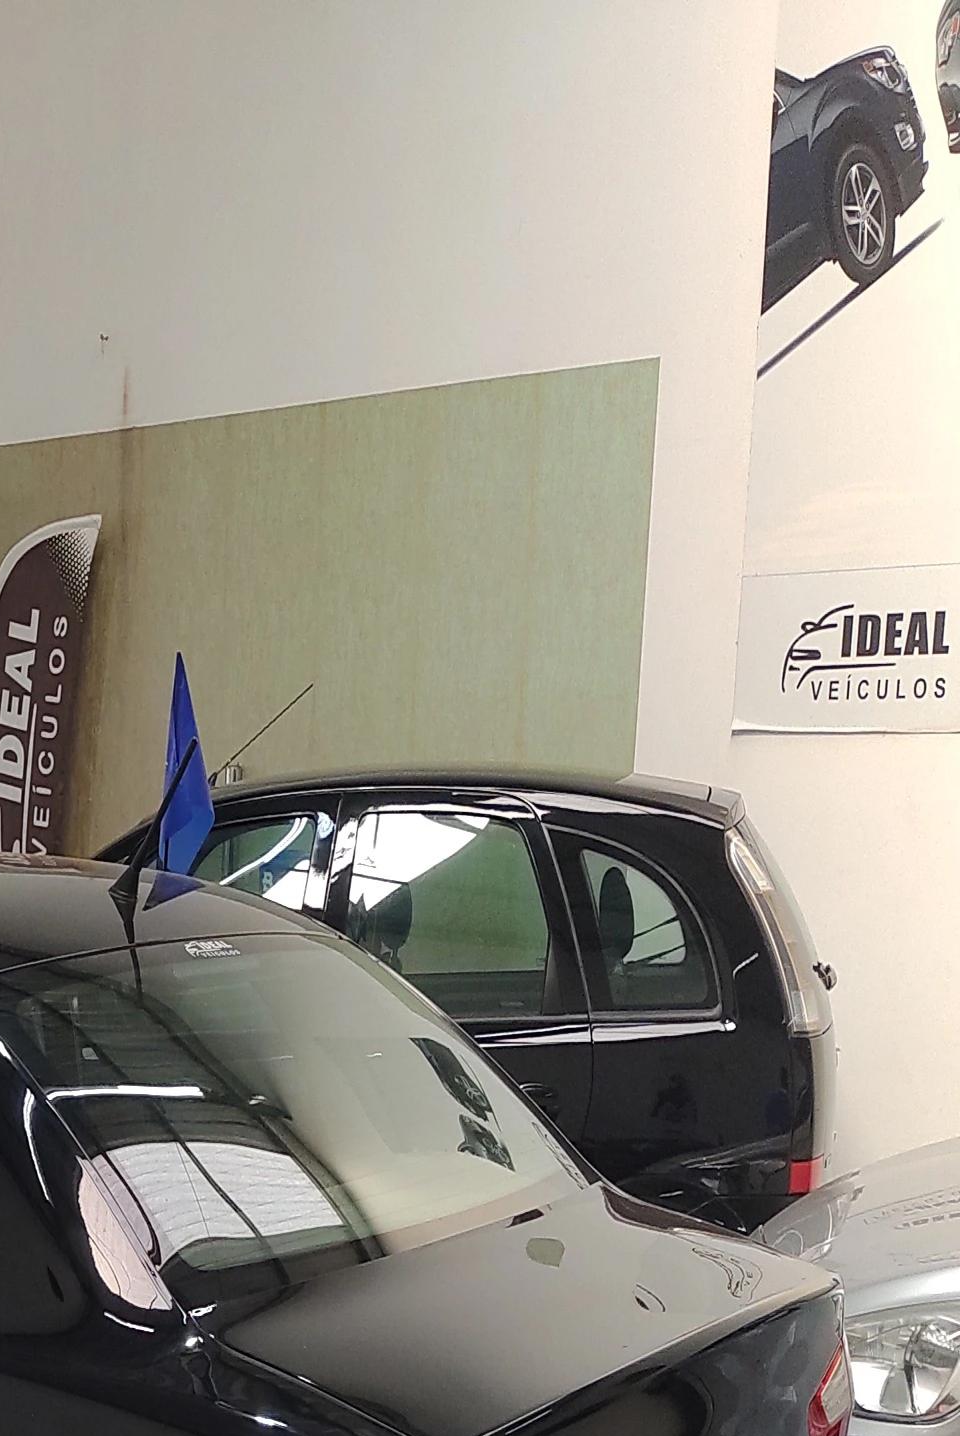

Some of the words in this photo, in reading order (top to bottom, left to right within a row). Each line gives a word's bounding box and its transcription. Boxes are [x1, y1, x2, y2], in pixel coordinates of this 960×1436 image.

[841, 611, 949, 657] IDEAL
[811, 674, 946, 700] VEÍCULOS
[30, 615, 69, 858] VEÍCULOS
